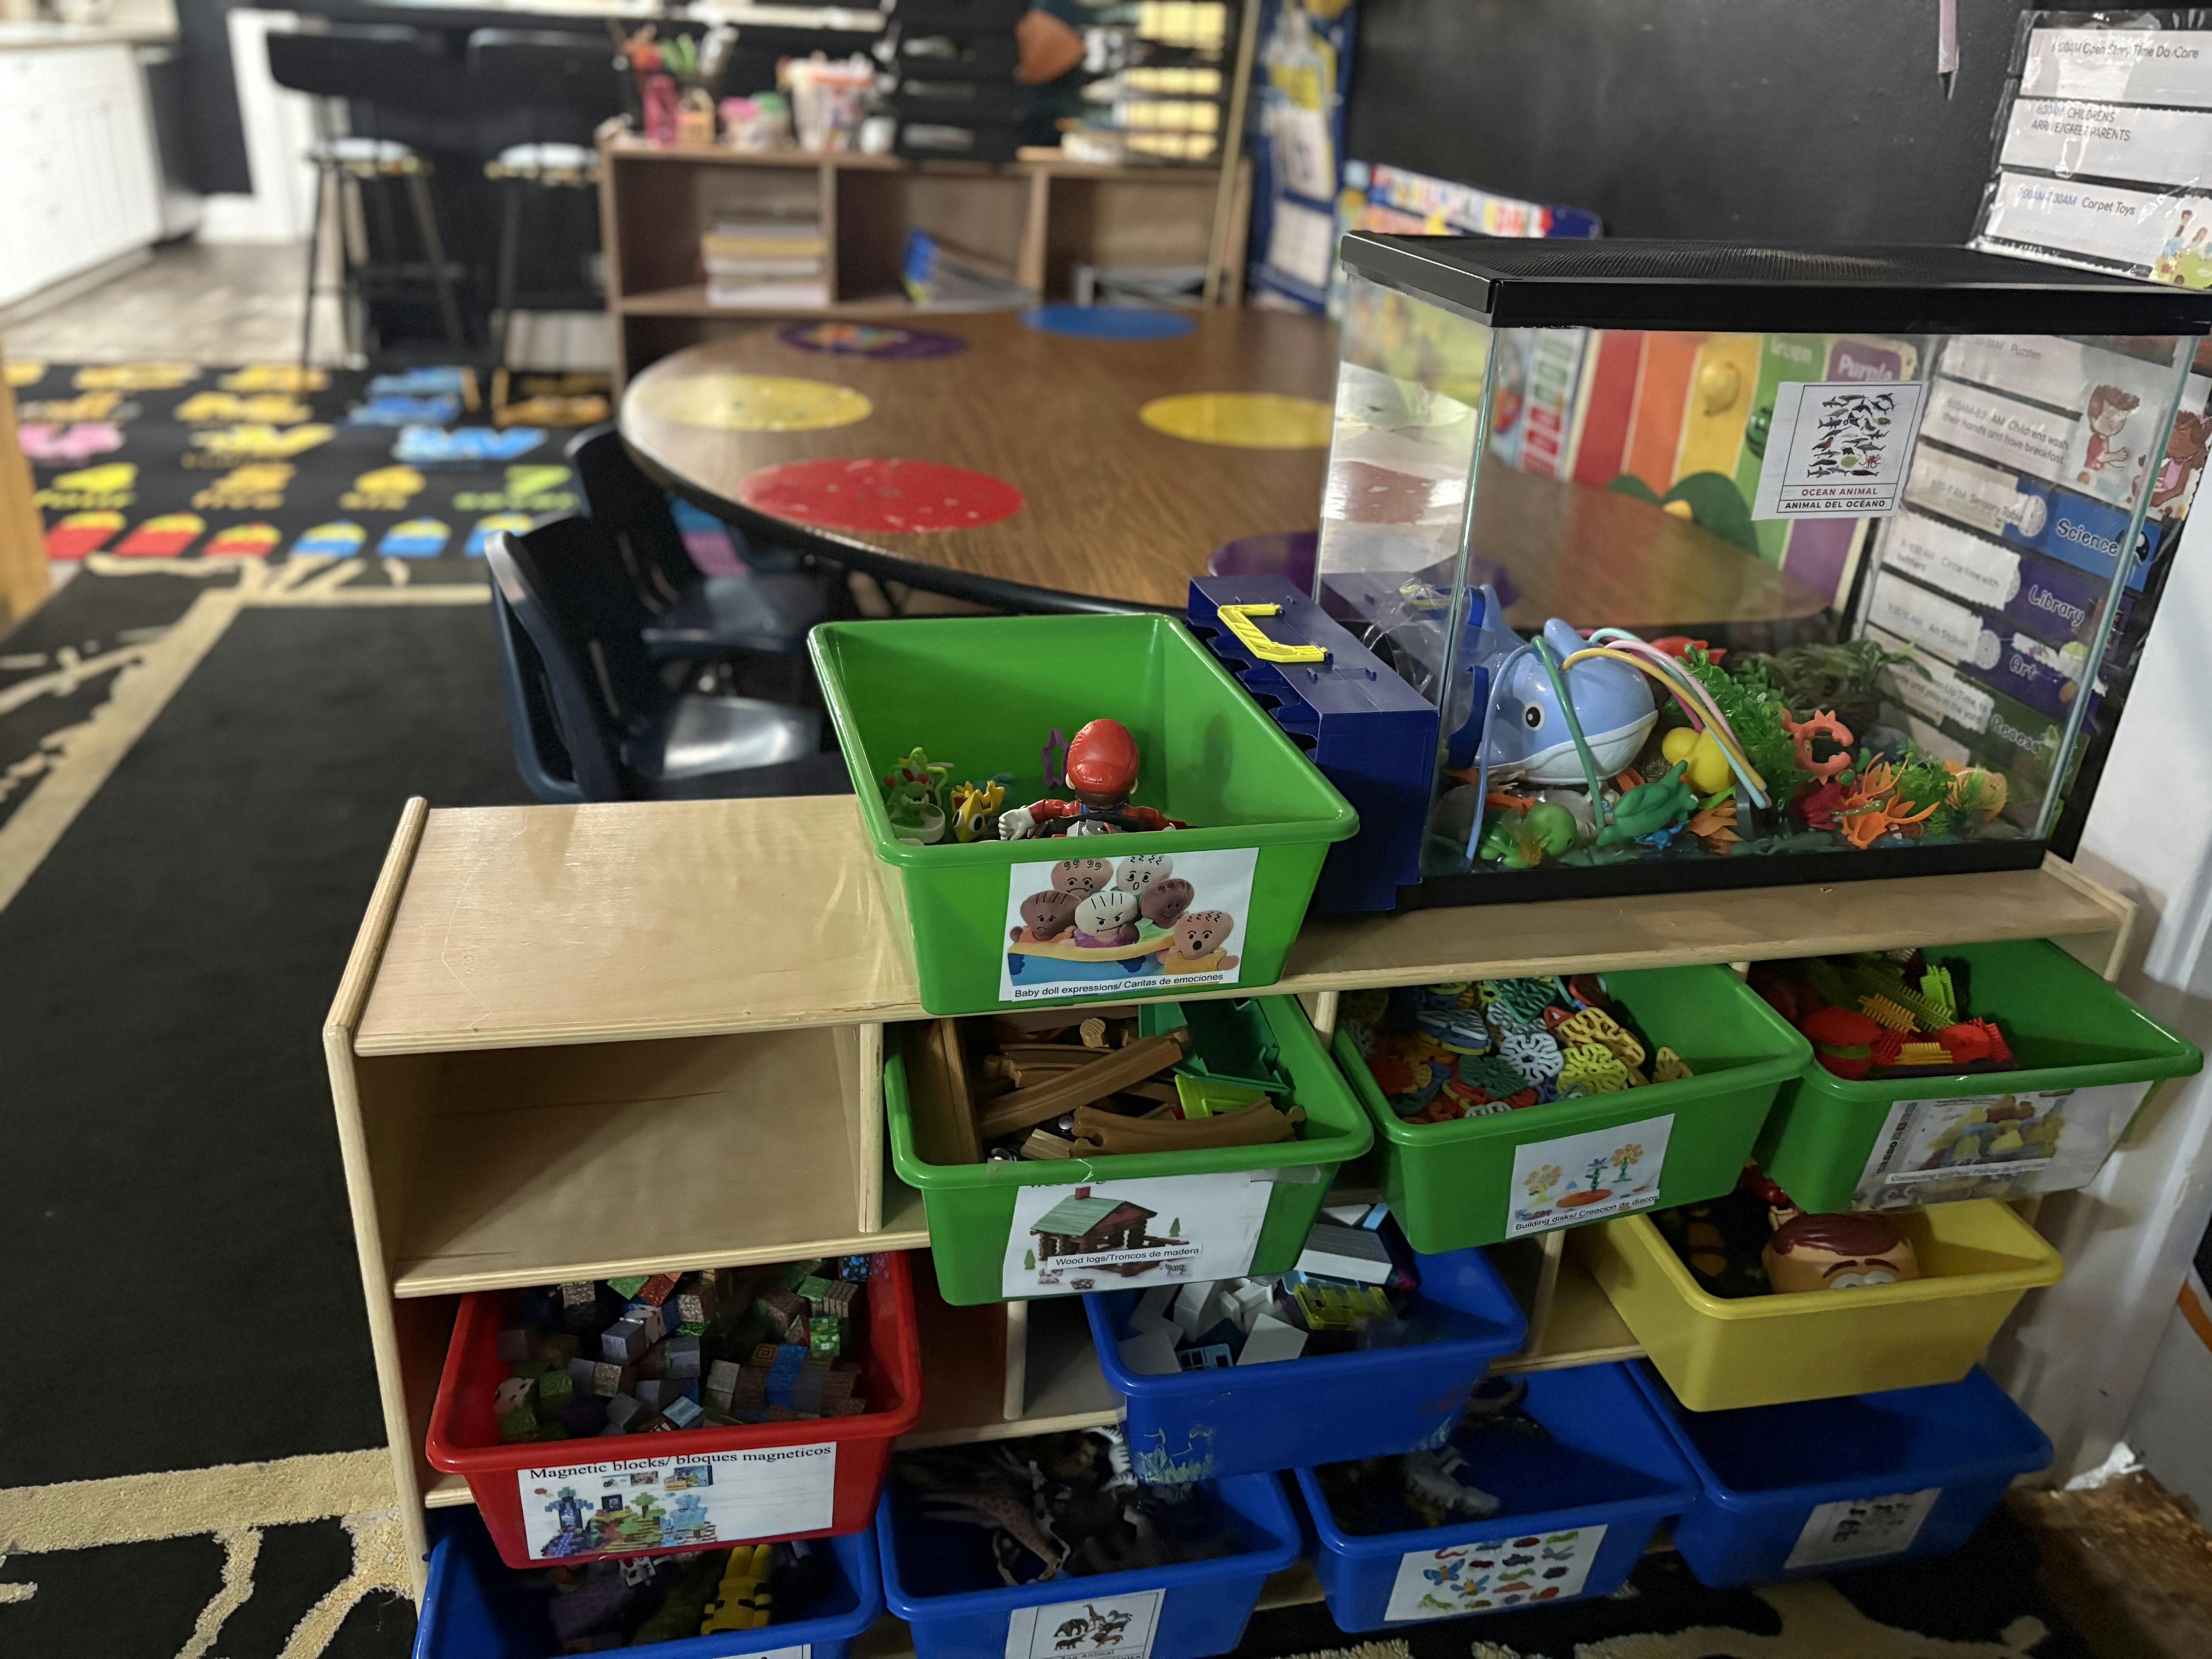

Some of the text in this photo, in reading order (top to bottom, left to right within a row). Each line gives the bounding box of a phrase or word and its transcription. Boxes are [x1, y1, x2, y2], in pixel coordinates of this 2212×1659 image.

[2083, 43, 2106, 55] Open
[2133, 45, 2154, 57] Time
[2067, 107, 2116, 123] CHILDRENS
[2090, 126, 2131, 141] PARENTS
[2082, 197, 2114, 212] Carpet
[2116, 202, 2136, 216] Toys
[2011, 343, 2042, 360] Puzzles
[1838, 354, 1893, 381] Purple
[2004, 434, 2023, 449] have
[2008, 420, 2047, 442] Childrens
[2048, 437, 2069, 450] wash
[2056, 518, 2119, 556] Science
[2028, 584, 2085, 627] Library
[2009, 654, 2037, 680] Art
[1991, 713, 2041, 754] Recess
[1015, 989, 1039, 998] Baby
[1042, 987, 1059, 995] doll
[1061, 982, 1122, 994] expressions/
[1124, 980, 1156, 988] Caritas
[1173, 974, 1223, 984] emociones
[1516, 1219, 1549, 1230] Building
[1632, 1195, 1659, 1205] discos
[1056, 1257, 1084, 1266] Wood
[1086, 1253, 1146, 1264] logs/Troncos
[1164, 1247, 1199, 1257] madera
[530, 1446, 831, 1479] Magnetic blocks/ bloques magneticos
